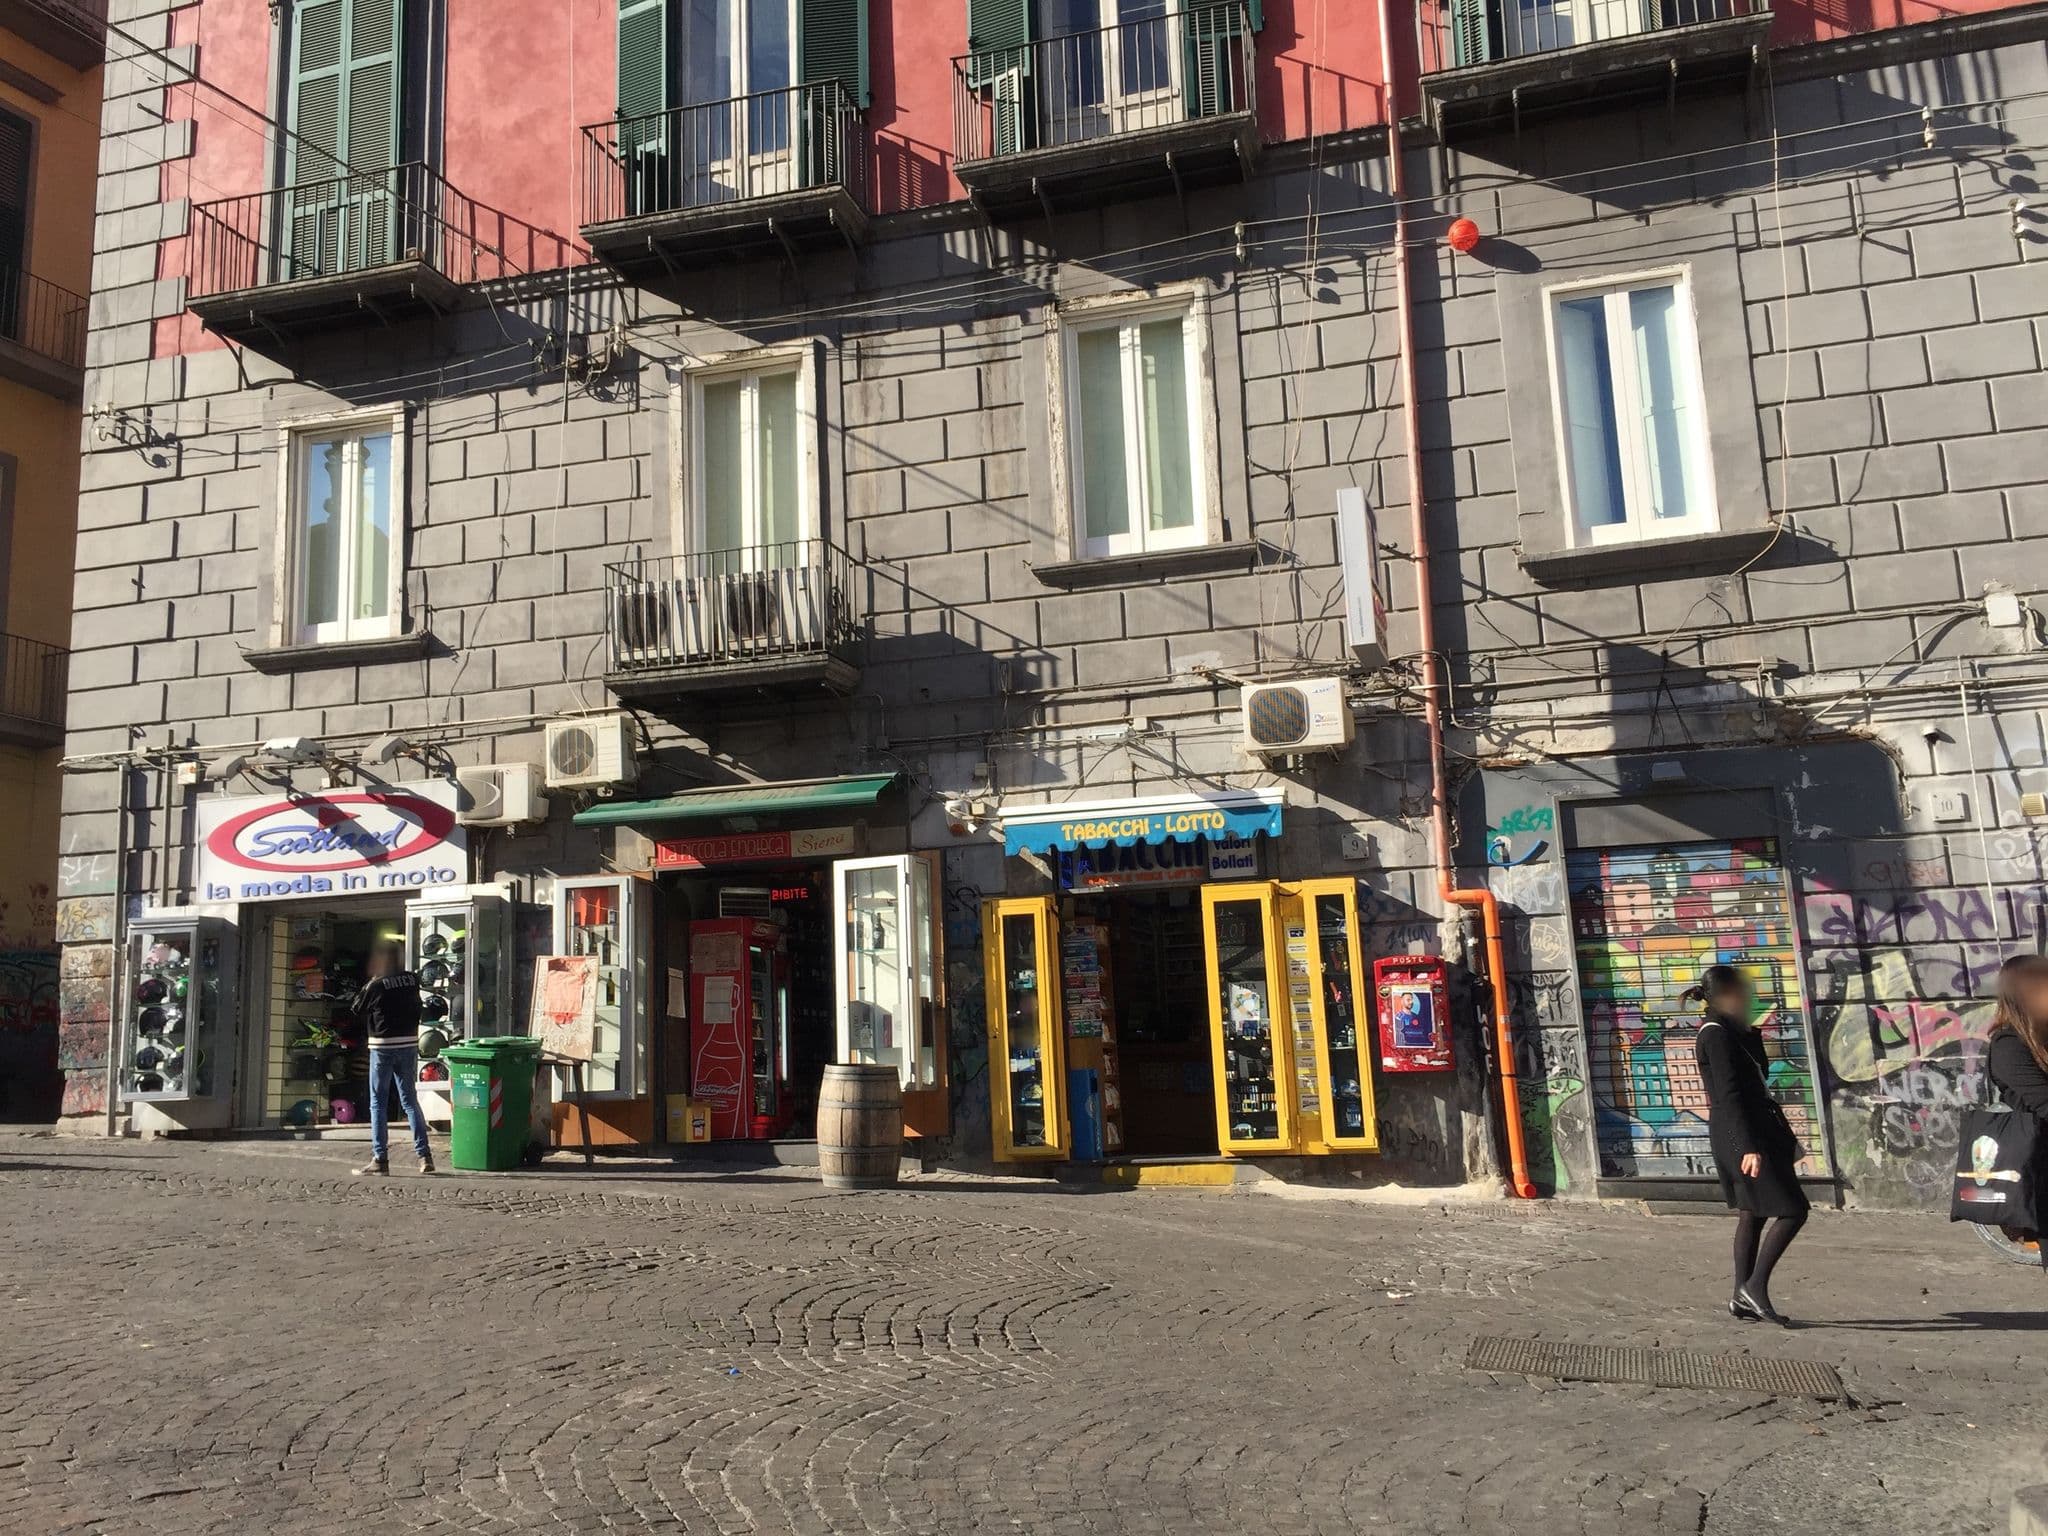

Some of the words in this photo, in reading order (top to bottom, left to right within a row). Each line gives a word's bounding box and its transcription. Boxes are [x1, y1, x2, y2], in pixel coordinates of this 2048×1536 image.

[1940, 799, 1953, 813] 10
[1061, 818, 1150, 841] TABACCHI
[1165, 811, 1226, 833] LOTTO
[247, 819, 408, 858] Scotland
[1351, 839, 1359, 852] 9
[1212, 855, 1253, 870] Bollati
[206, 881, 231, 900] la
[241, 874, 333, 898] moda
[341, 871, 367, 890] in
[378, 864, 457, 887] moto
[771, 887, 809, 901] BIBITE
[1392, 956, 1425, 964] POSTE
